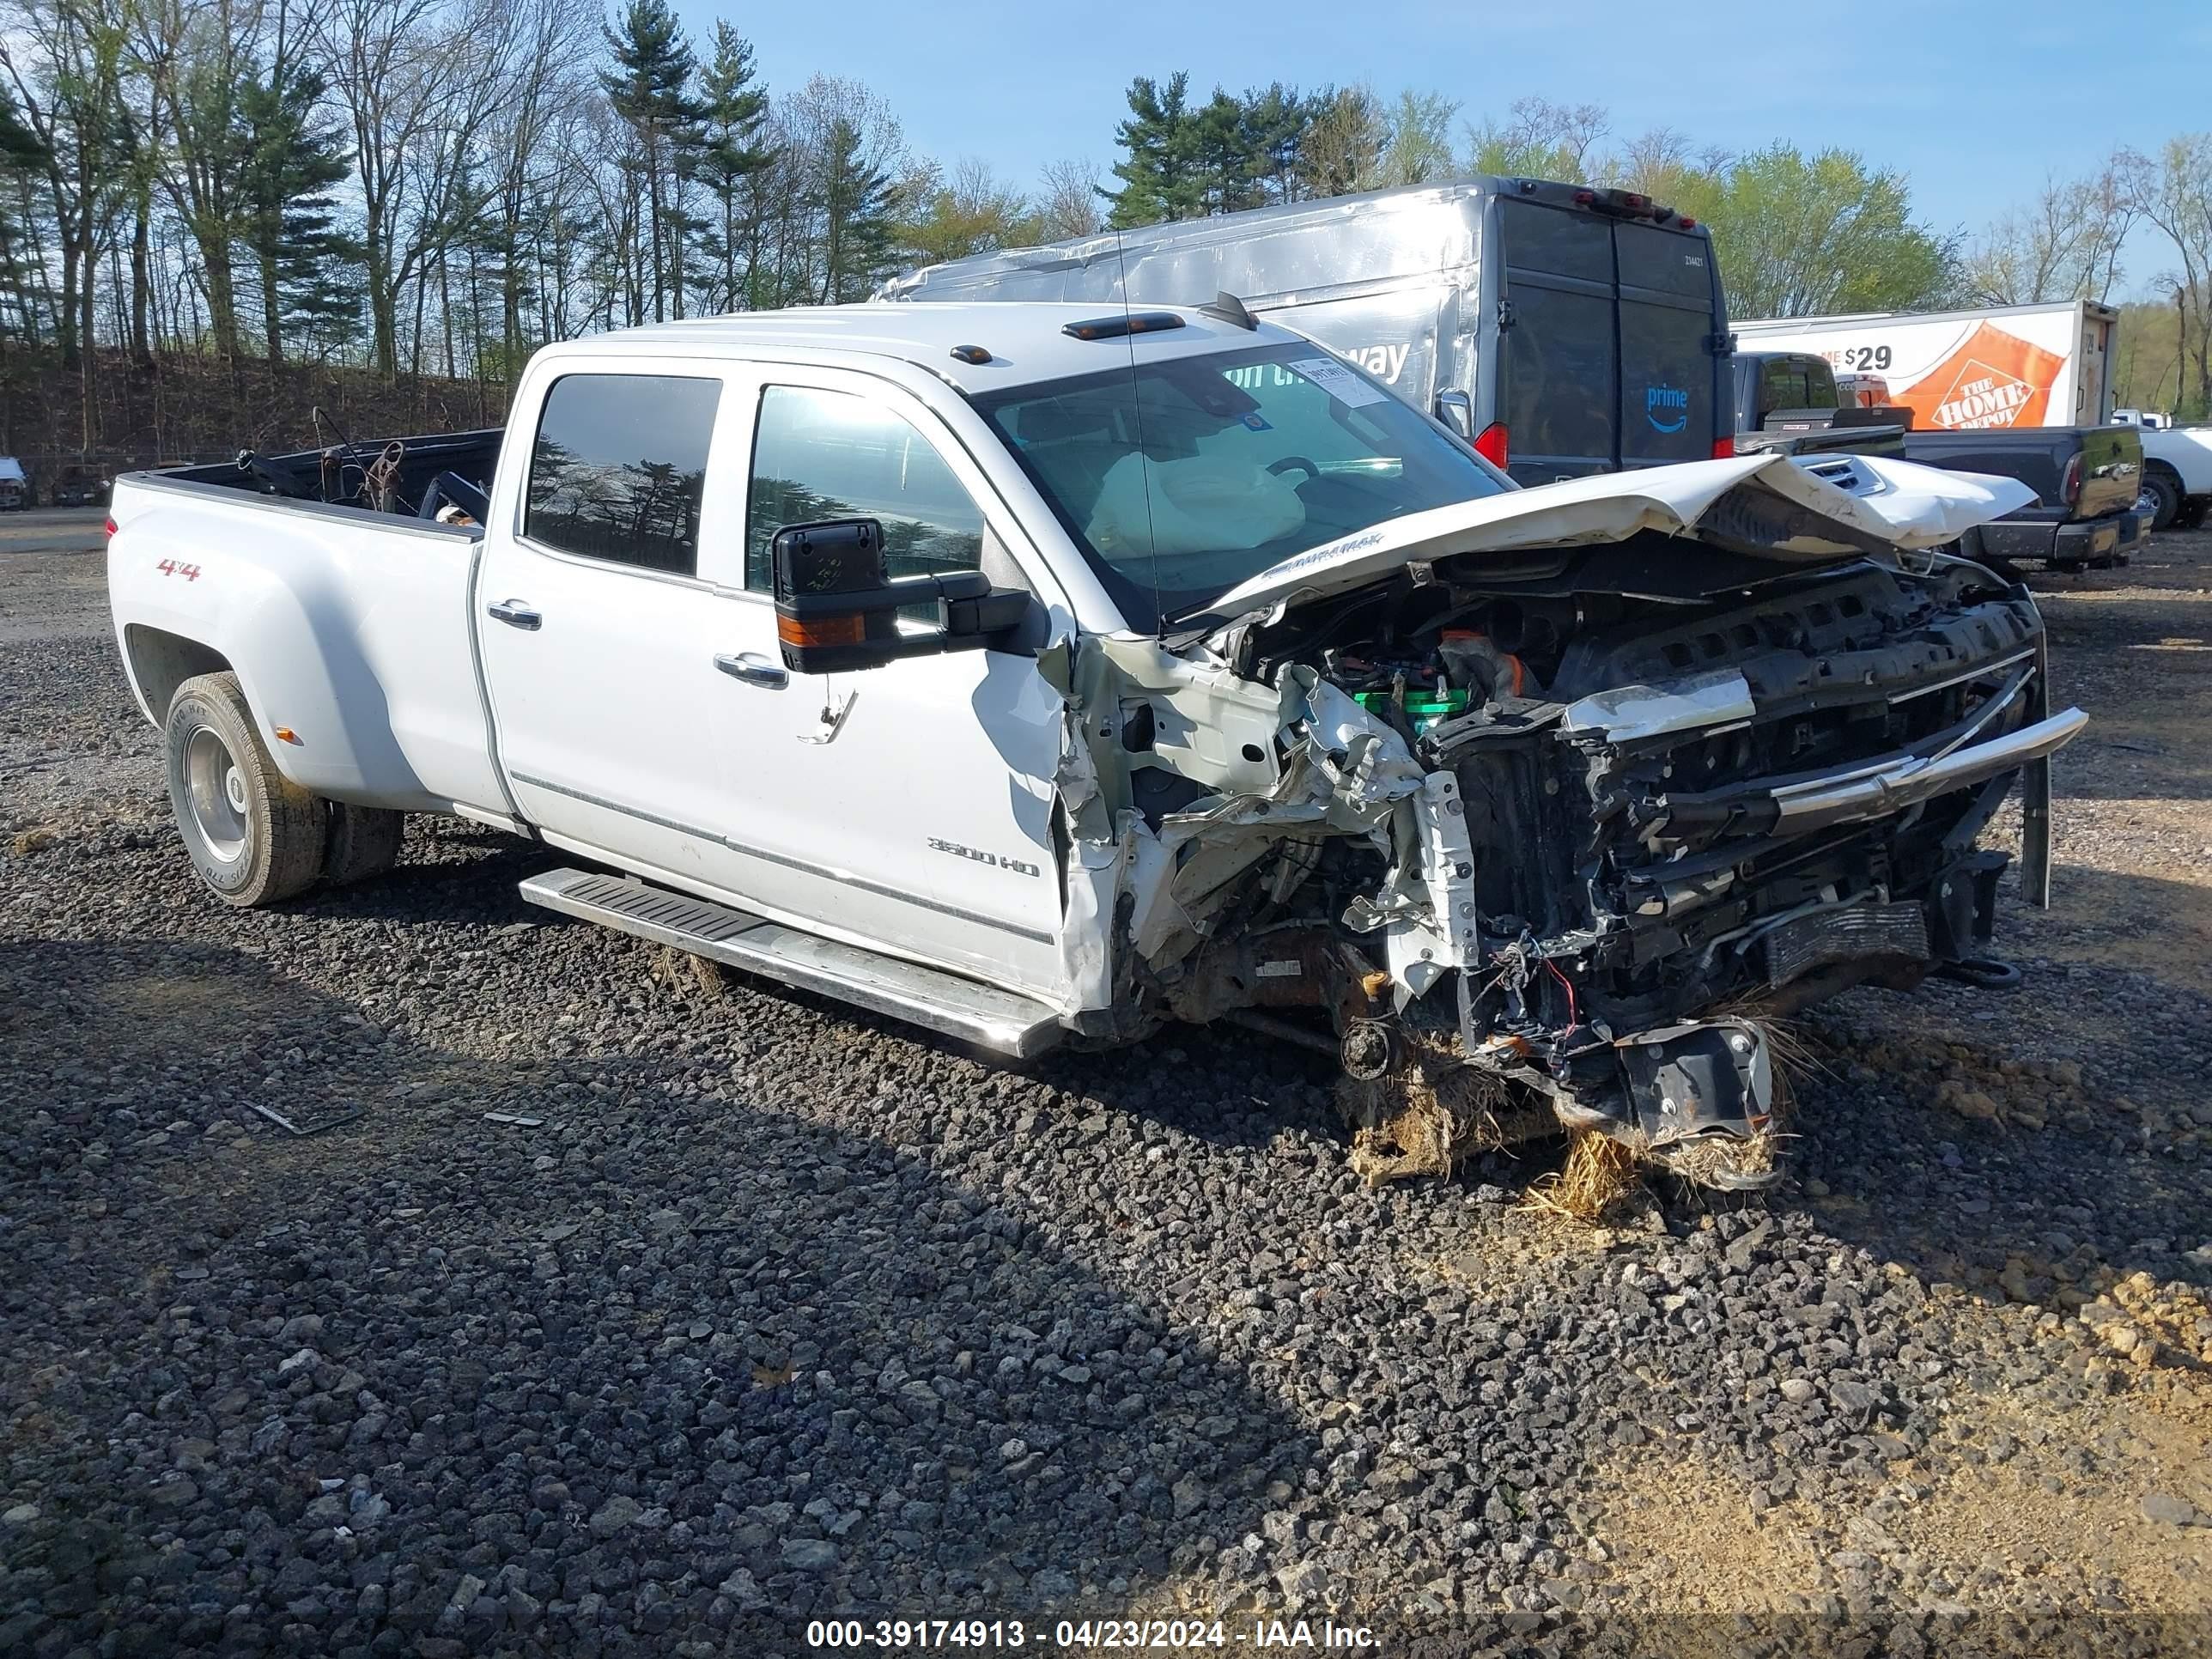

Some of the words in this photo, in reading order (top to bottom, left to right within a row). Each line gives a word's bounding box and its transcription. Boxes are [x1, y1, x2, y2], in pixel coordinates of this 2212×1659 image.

[1844, 345, 1892, 372] $29
[1648, 382, 1687, 412] prime
[1960, 377, 1995, 397] THE
[1941, 382, 2027, 427] HOME
[927, 836, 996, 866] 3500
[1000, 856, 1040, 878] HD
